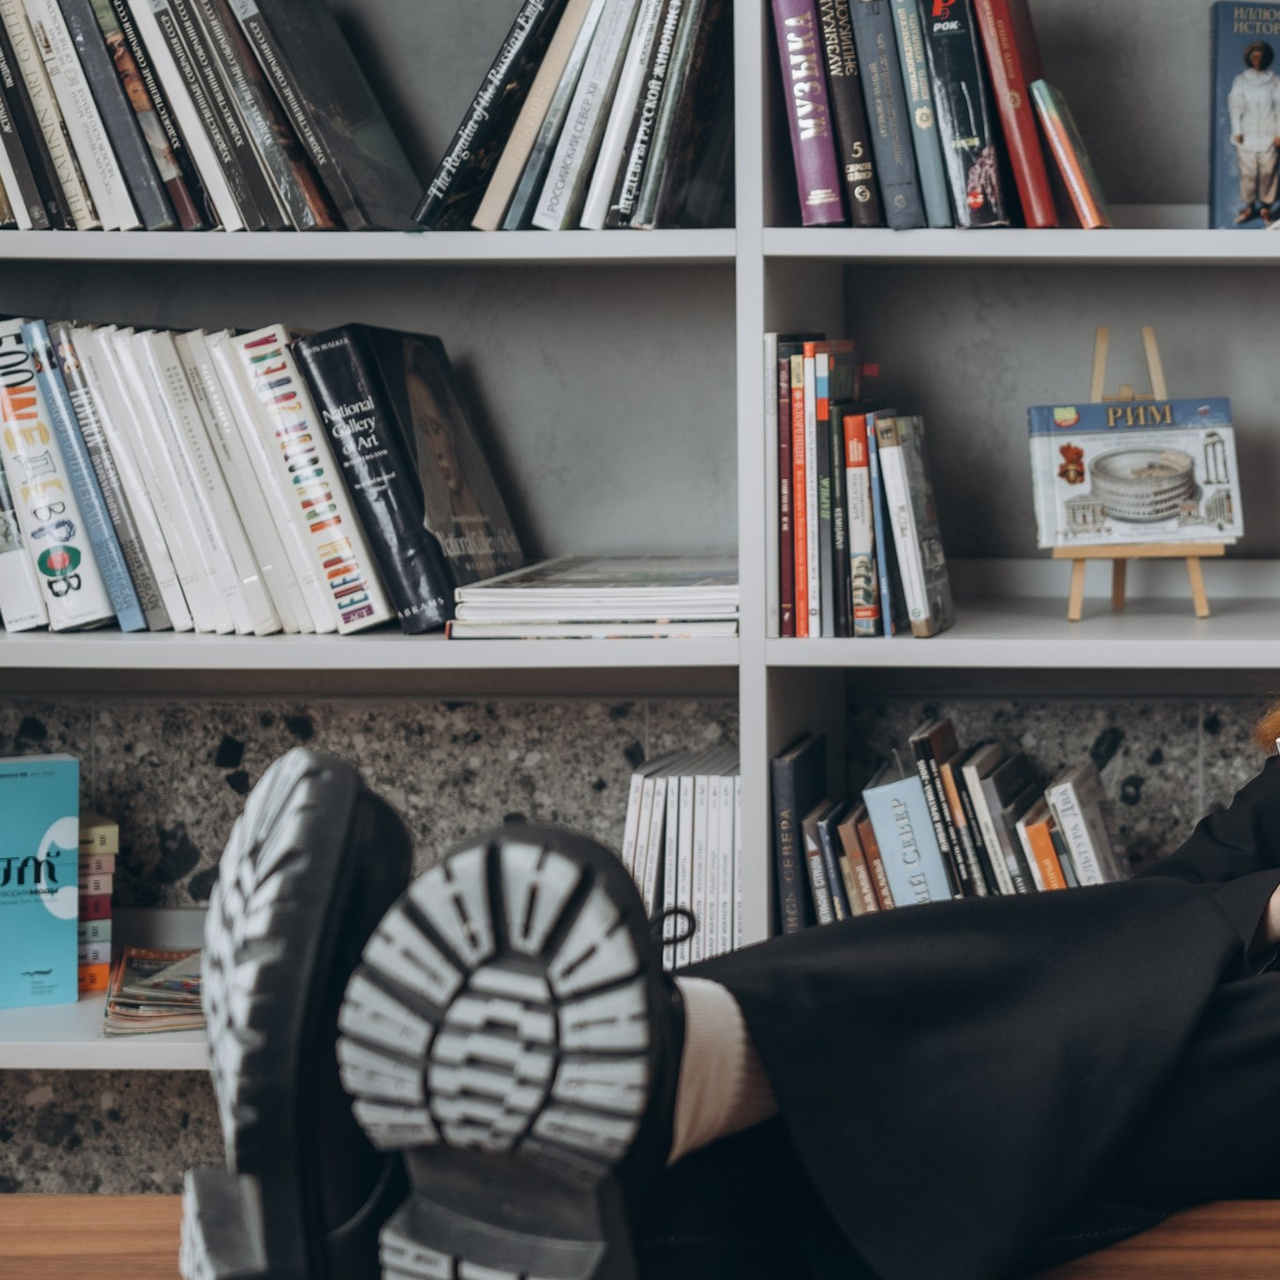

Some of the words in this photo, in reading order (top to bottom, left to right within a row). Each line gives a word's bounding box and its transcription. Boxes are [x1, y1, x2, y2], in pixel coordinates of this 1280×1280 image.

[122, 22, 148, 68] СОБРАНИЯ
[159, 14, 176, 39] СССР
[169, 37, 196, 83] СОБРАНИЯ
[485, 26, 527, 86] Russian
[23, 67, 46, 101] ART
[783, 10, 827, 141] МУЗЫКА
[72, 91, 85, 117] МУЗЕИ
[140, 67, 182, 149] ХУДОЖЕСТВЕННЫЕ
[474, 81, 497, 108] the
[188, 82, 233, 164] ХУДОЖЕСТВЕННЫЕ
[468, 103, 490, 124] of
[37, 107, 75, 186] KALININ
[84, 122, 113, 195] ГОСУДАРСТВЕННЫЕ
[441, 118, 483, 175] Regalia
[617, 143, 647, 214] ШЕДЕВРЫ
[634, 79, 662, 143] РУССКОЙ
[851, 141, 863, 158] 5
[427, 168, 454, 200] The
[65, 188, 88, 224] THE
[322, 395, 374, 424] National
[332, 416, 376, 439] Gallery
[1107, 405, 1172, 427] РИМ
[819, 474, 831, 520] ПАРИЖ
[138, 571, 159, 610] МУЗЕИ
[396, 597, 445, 619] ABRAMS
